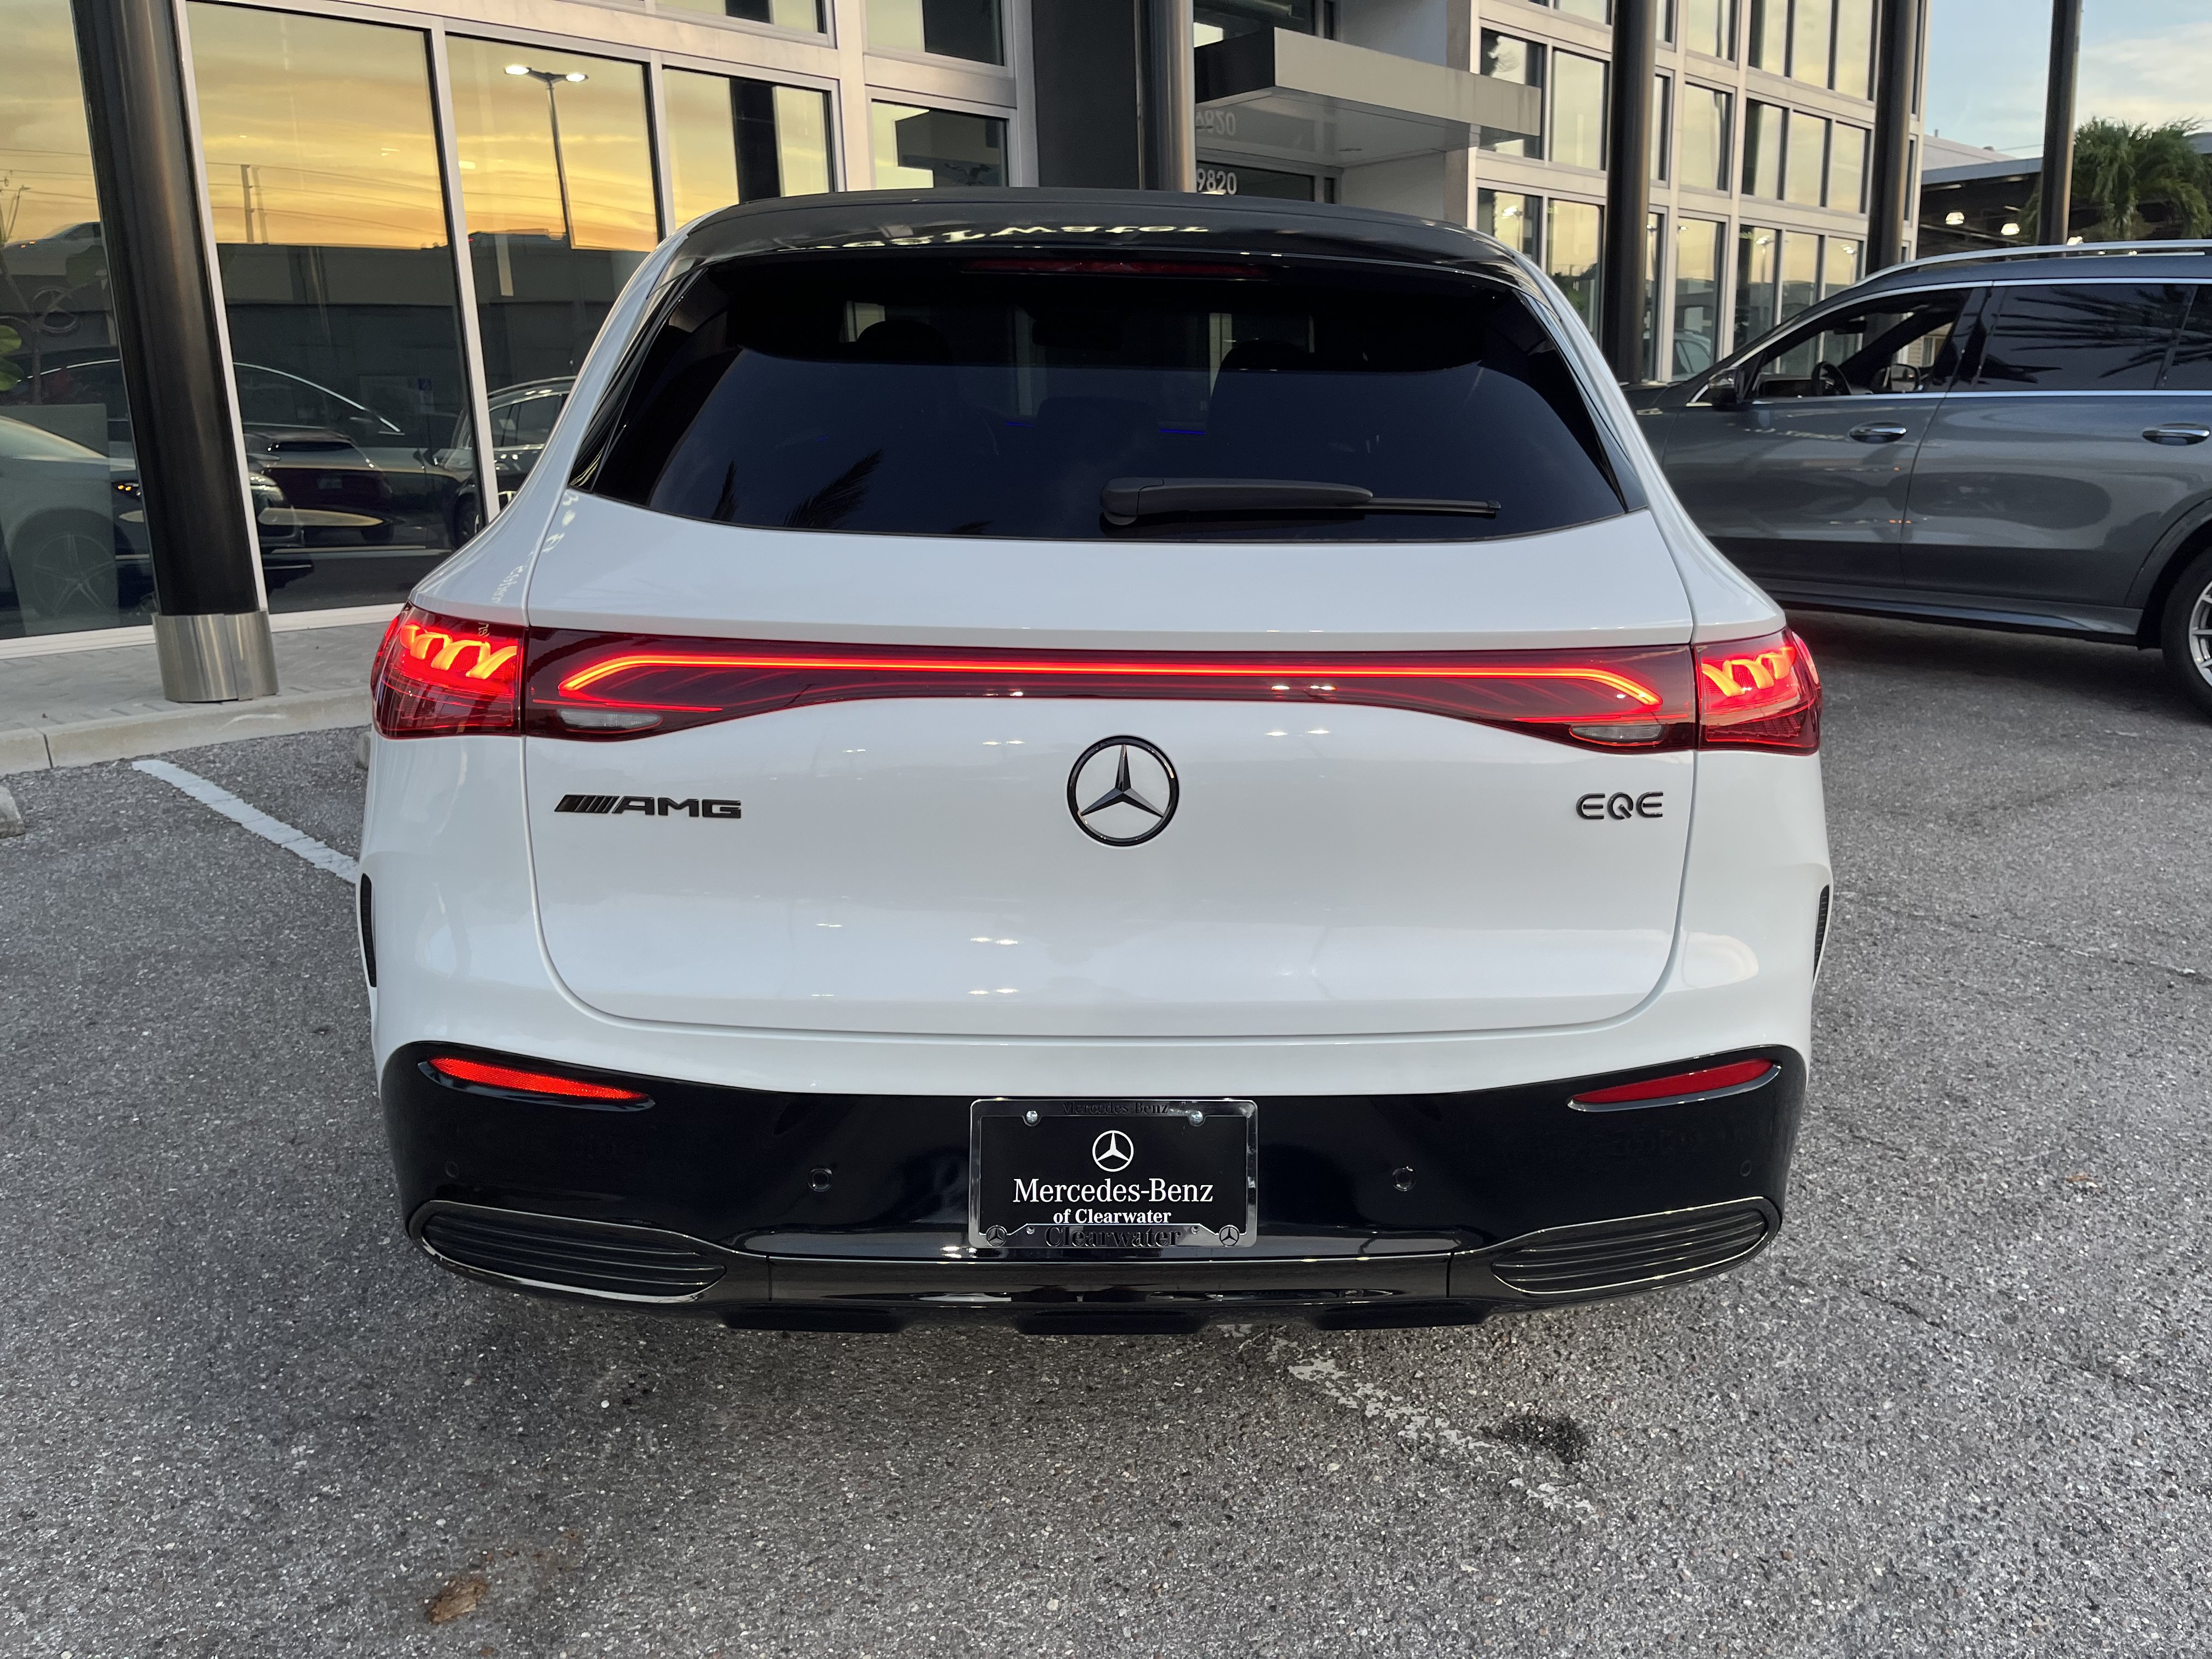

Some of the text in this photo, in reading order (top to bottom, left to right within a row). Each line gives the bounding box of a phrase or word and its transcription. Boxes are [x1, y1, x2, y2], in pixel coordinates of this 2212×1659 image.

[1197, 168, 1237, 195] 9820
[610, 795, 741, 819] AMG
[1576, 791, 1664, 820] EQE
[1013, 1178, 1214, 1203] Mercedes-Benz
[1053, 1209, 1172, 1224] of Clearwater
[1045, 1226, 1181, 1248] Clearwater
